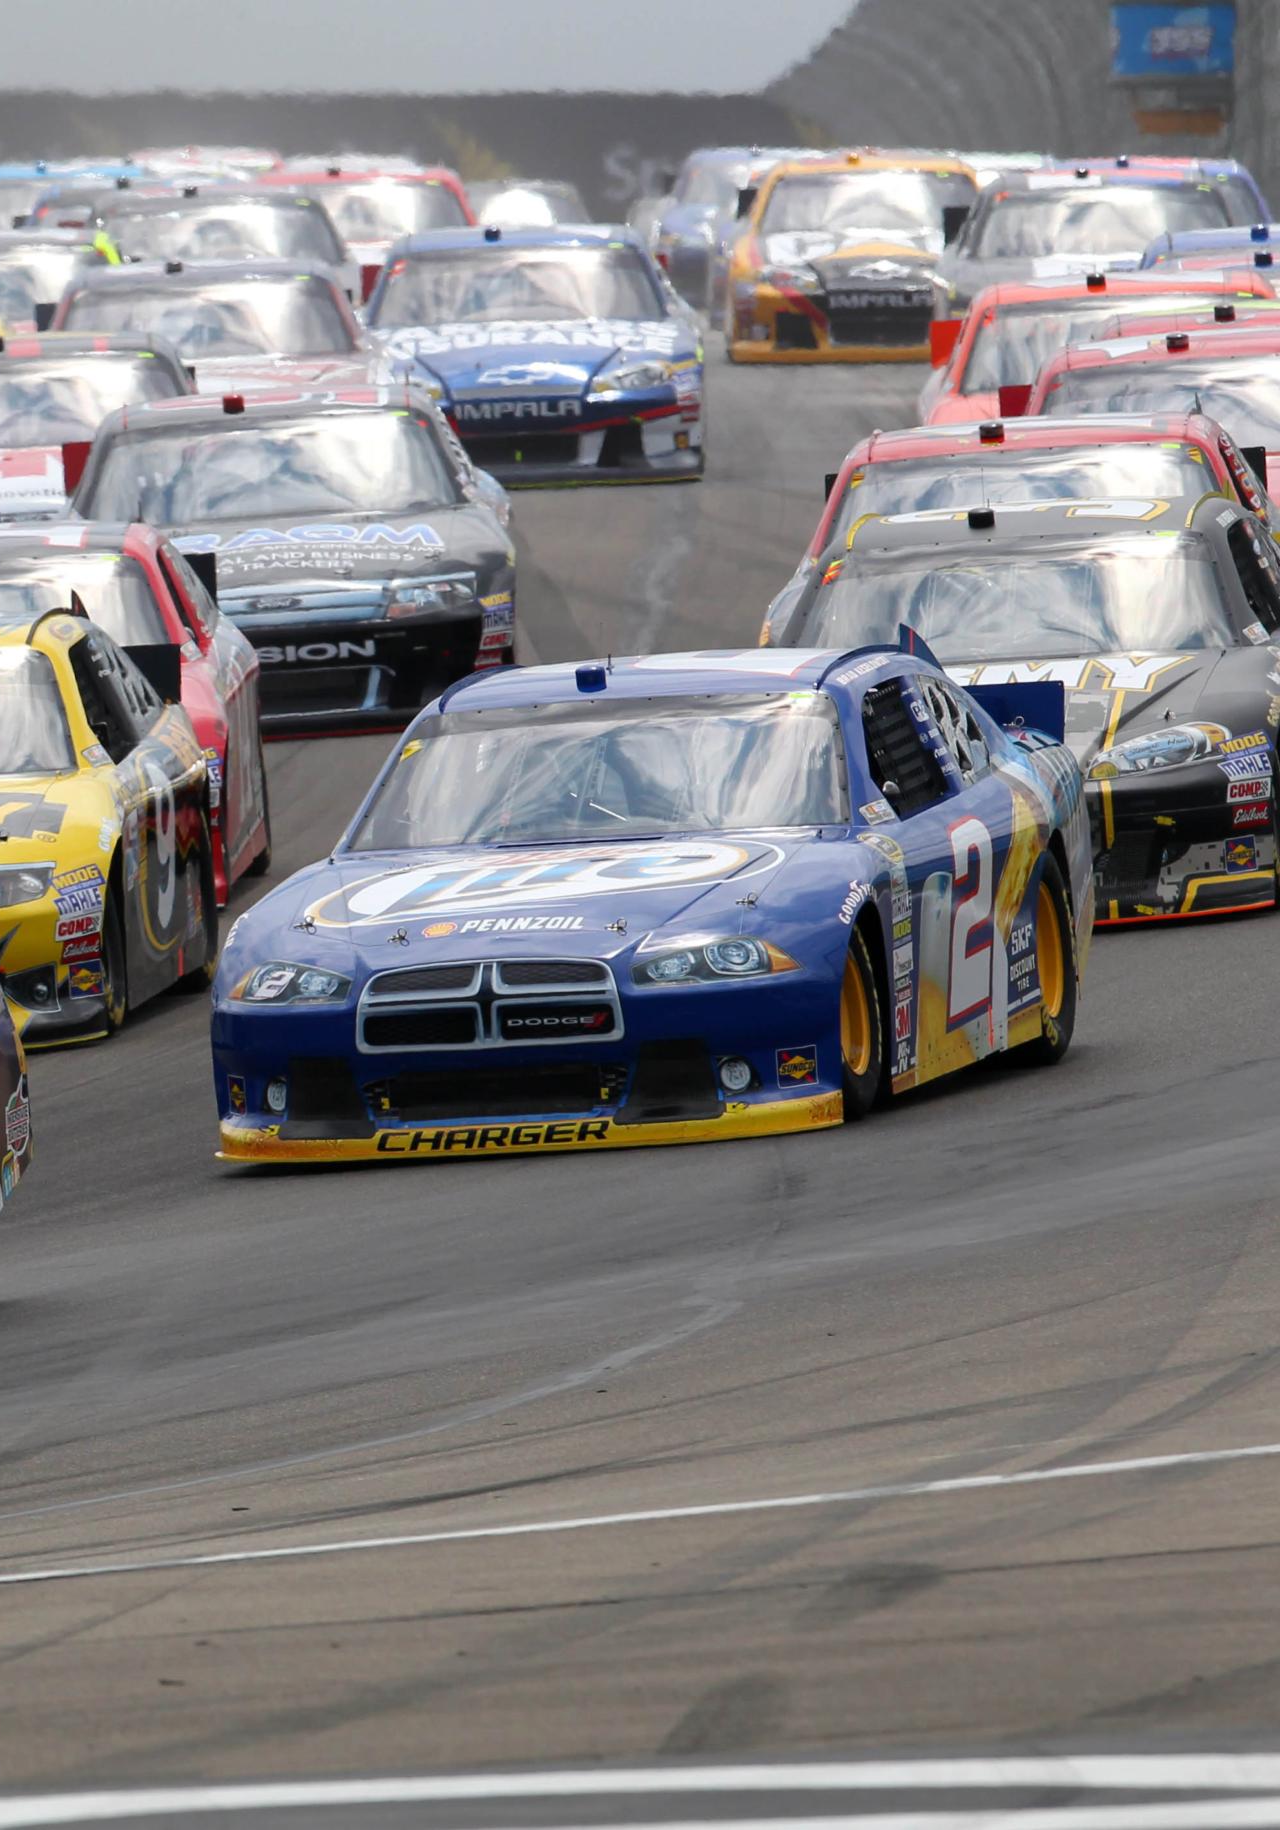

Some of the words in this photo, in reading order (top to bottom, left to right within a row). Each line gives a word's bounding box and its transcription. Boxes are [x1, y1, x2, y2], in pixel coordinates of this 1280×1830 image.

[454, 399, 583, 420] IMPALA
[310, 550, 416, 562] BUSINESS
[1219, 731, 1268, 755] MOOG
[1220, 753, 1271, 779] MAHLE
[1229, 780, 1262, 799] COMP
[53, 865, 98, 892] MOOG
[56, 887, 102, 916] MAHLE
[58, 916, 93, 937] COMP
[459, 916, 585, 935] PENNZOIL
[948, 818, 993, 1020] 2
[1011, 923, 1033, 956] SKF
[1010, 953, 1036, 983] DISCOUNT
[252, 969, 297, 1000] 2
[1016, 976, 1031, 992] TIRE
[506, 1014, 596, 1027] DODGE
[895, 1001, 911, 1041] 3M
[778, 1059, 817, 1076] SUNOCO
[377, 1119, 611, 1152] CHARGER
